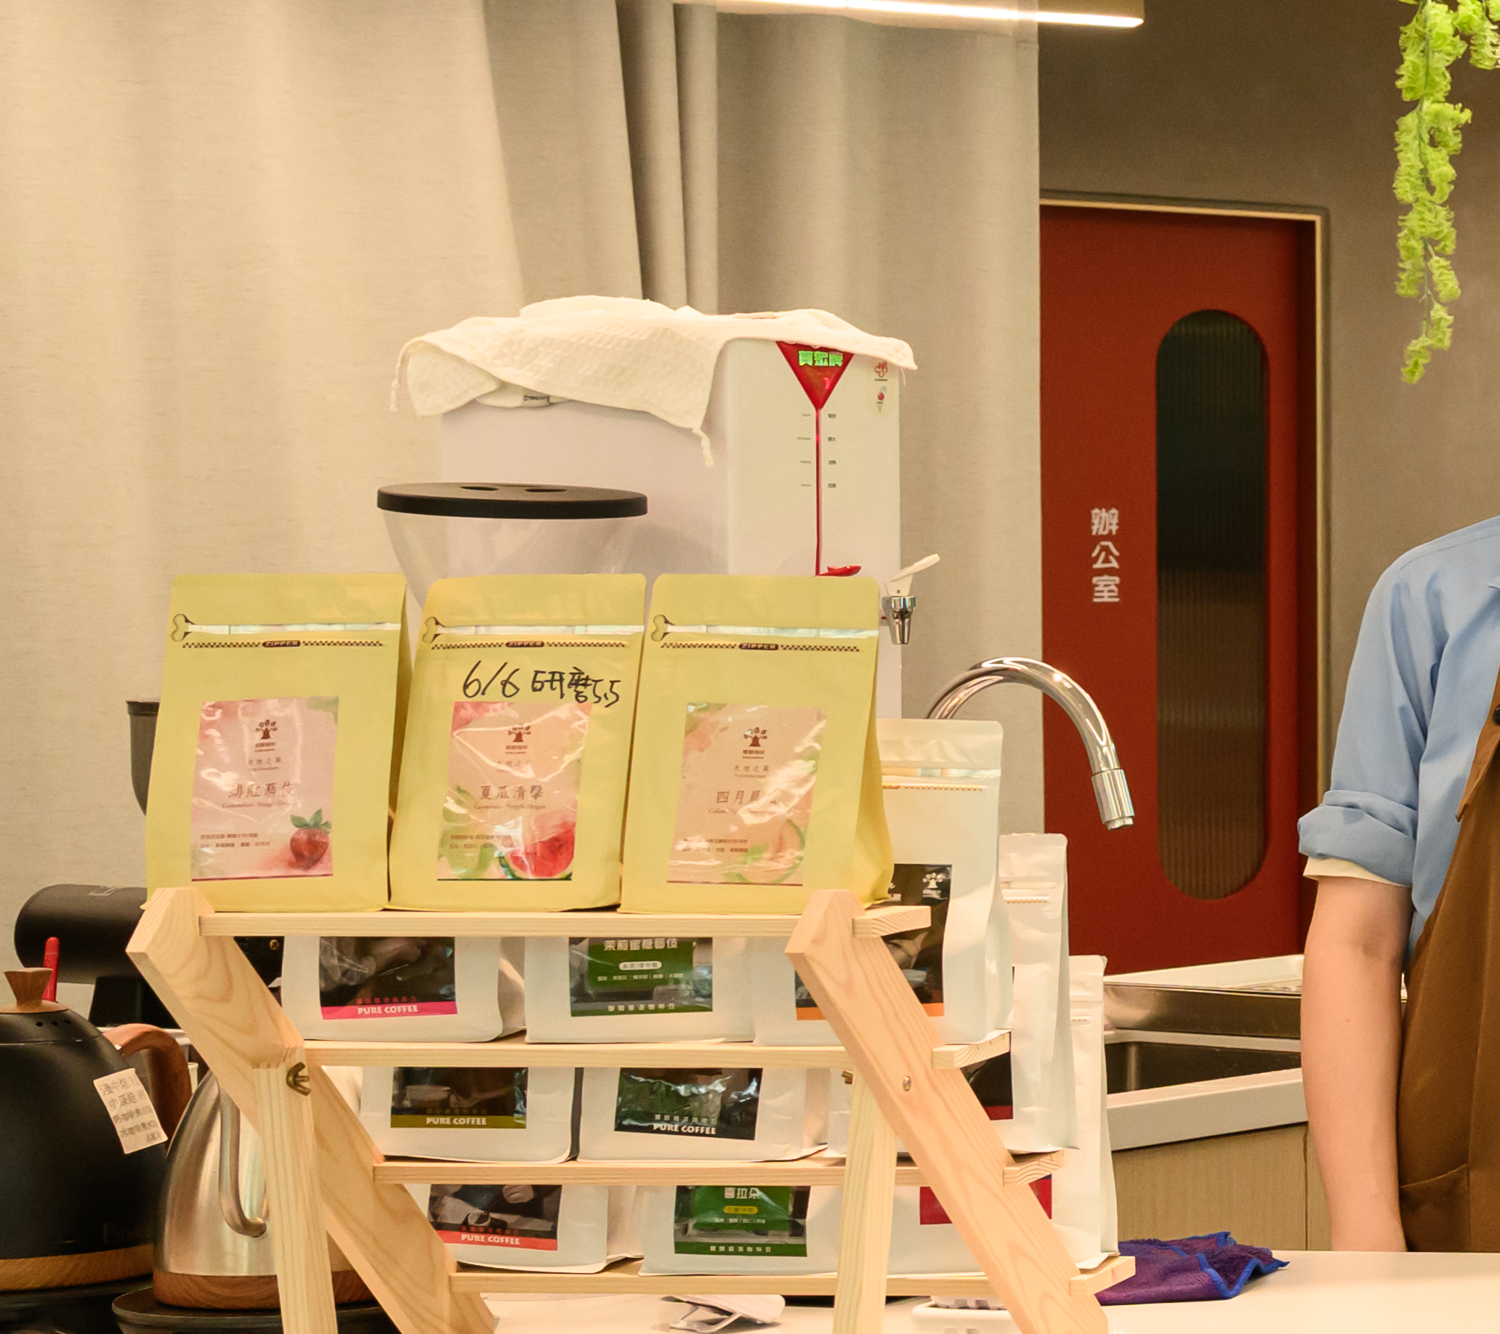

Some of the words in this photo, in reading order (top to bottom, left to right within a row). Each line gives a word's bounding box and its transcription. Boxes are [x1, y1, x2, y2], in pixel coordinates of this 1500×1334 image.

[1090, 506, 1121, 605] 辦公室
[462, 660, 520, 698] 6/6
[357, 1005, 383, 1015] PURE
[384, 1004, 419, 1014] COFFEE
[426, 1117, 450, 1126] PURE
[452, 1117, 487, 1126] COFFEE
[653, 1123, 679, 1133] PURE
[681, 1125, 717, 1135] COFFEE
[461, 1234, 486, 1243] PURE
[487, 1235, 520, 1246] COFFEE
